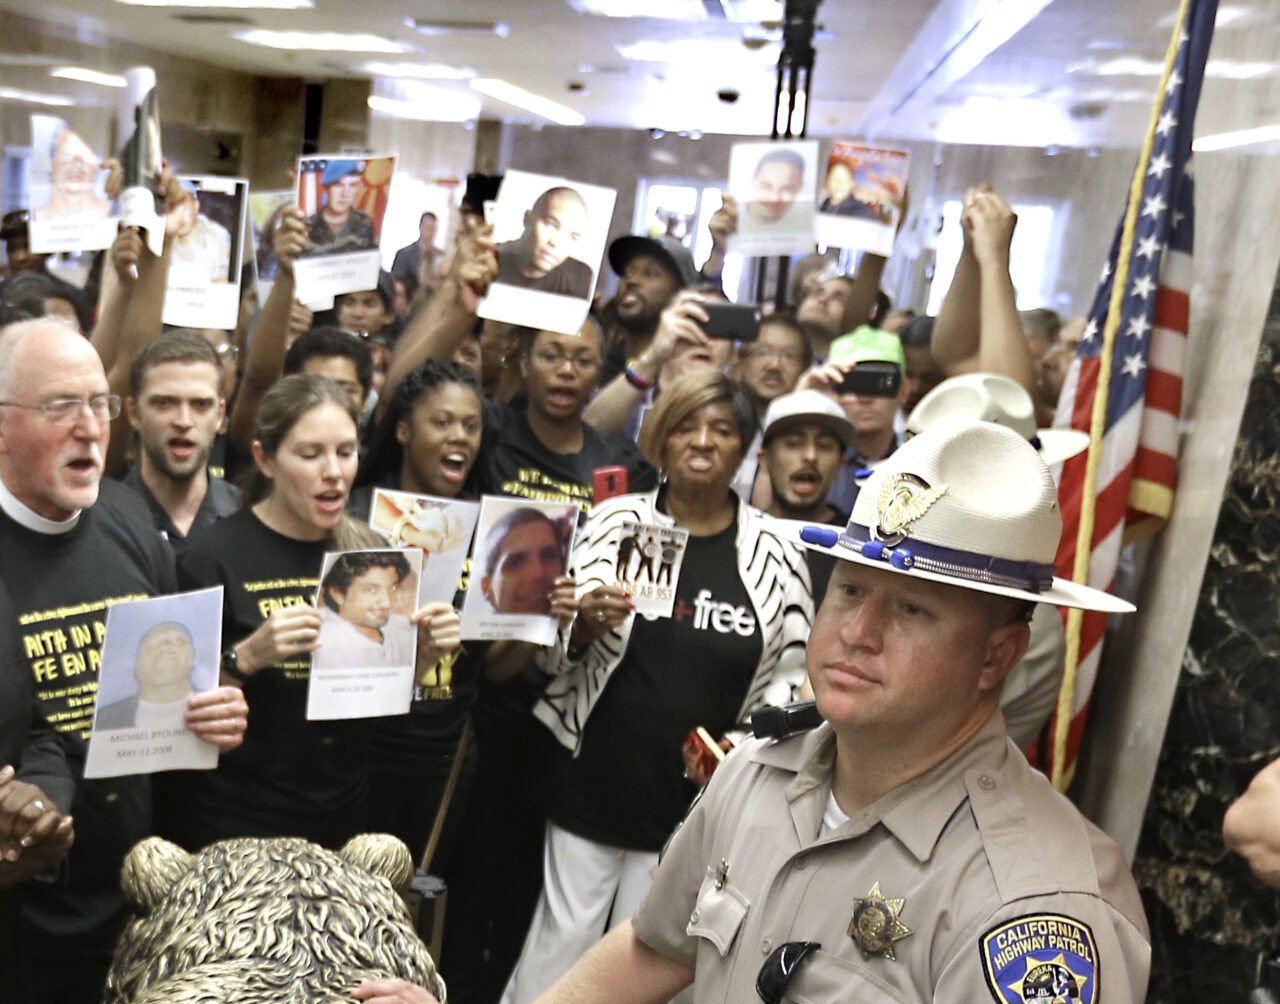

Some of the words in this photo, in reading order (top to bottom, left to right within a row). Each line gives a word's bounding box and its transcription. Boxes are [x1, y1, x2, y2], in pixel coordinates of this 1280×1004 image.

[656, 588, 673, 601] 953
[693, 589, 756, 637] free
[70, 623, 92, 648] IN
[33, 657, 59, 682] FE
[61, 651, 86, 677] EN
[110, 732, 149, 743] MICHAEL
[117, 749, 137, 759] MAY
[996, 921, 1081, 949] CALIFORNIA
[993, 936, 1045, 970] HIGHWAY
[1048, 936, 1093, 963] PATROL
